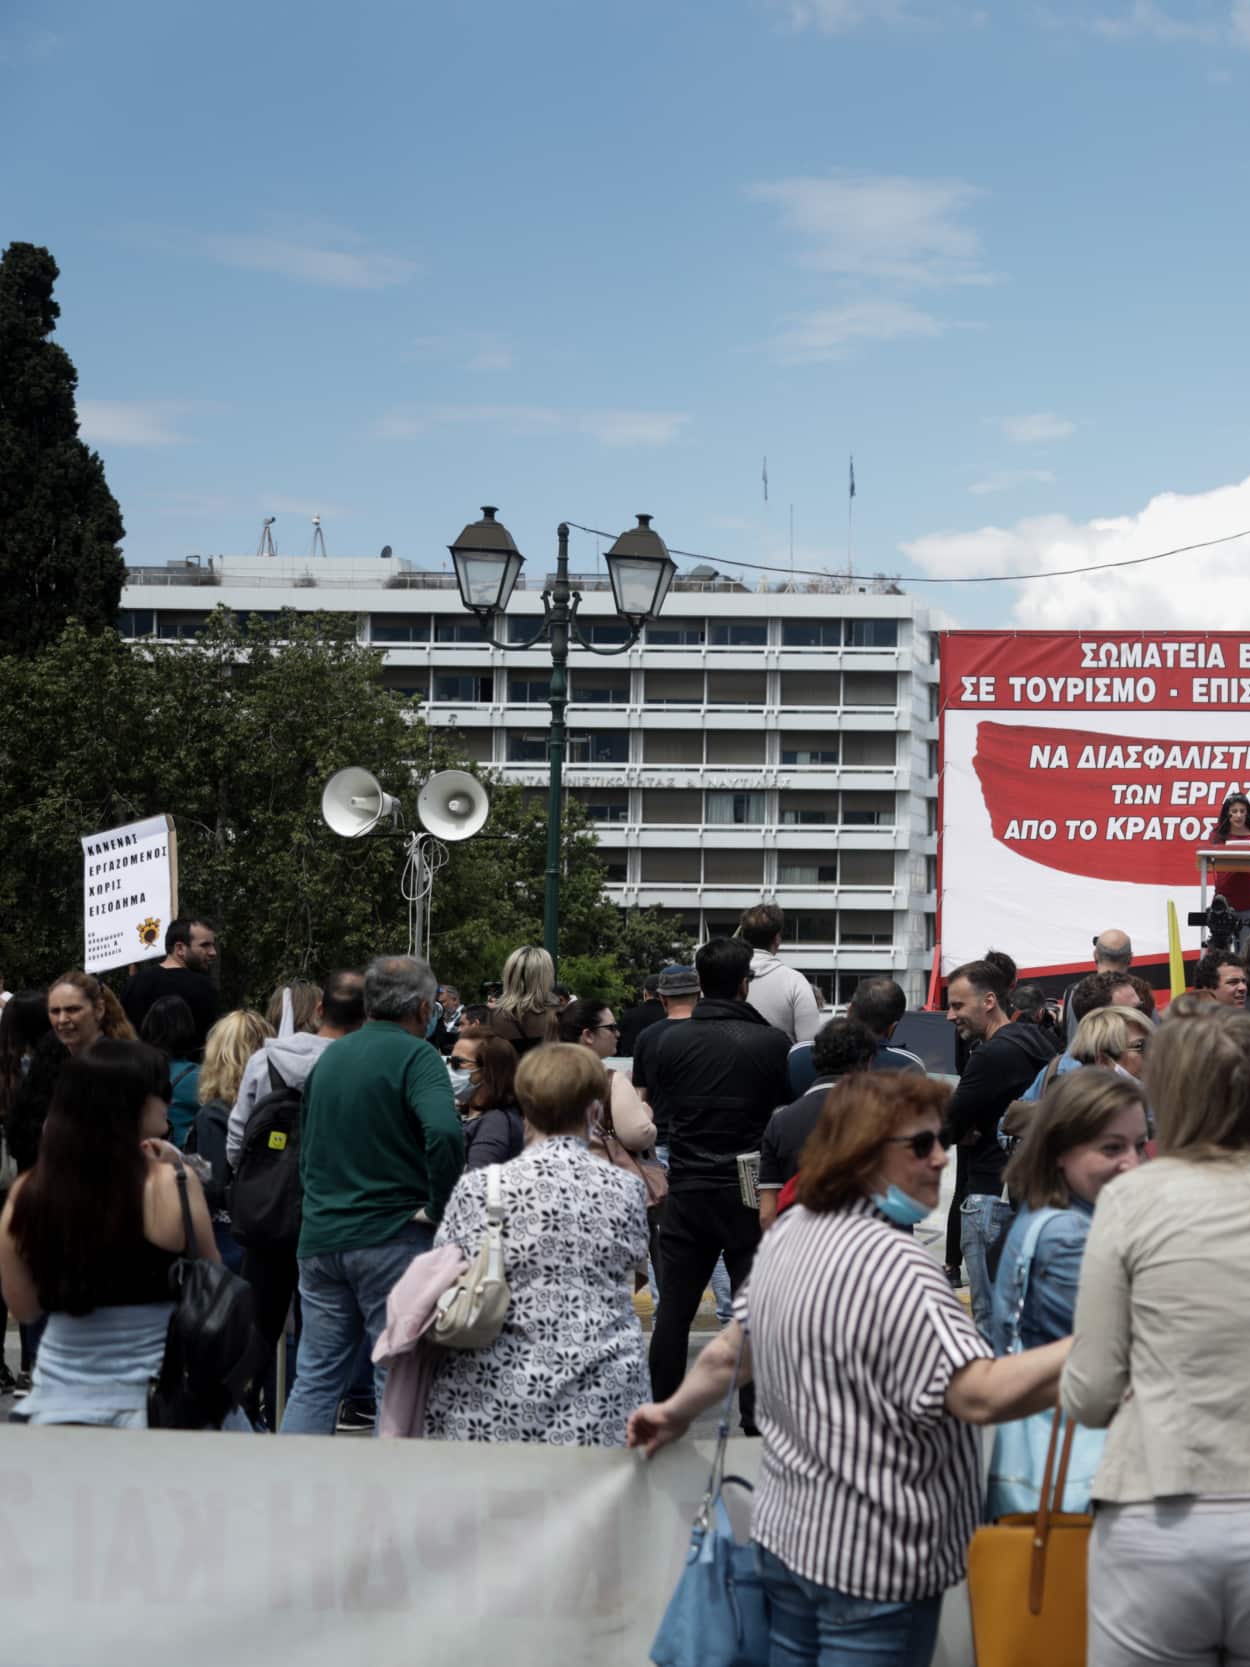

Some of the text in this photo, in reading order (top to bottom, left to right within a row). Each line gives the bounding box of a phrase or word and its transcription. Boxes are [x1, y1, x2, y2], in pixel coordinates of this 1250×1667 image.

[1080, 642, 1226, 669] ΣΩΜΑΤΕΙΑ
[960, 676, 996, 702] ΣΕ
[1008, 676, 1157, 703] ΤΟΥΡΙΣΜΟ
[1028, 744, 1069, 769] ΝΑ
[1111, 784, 1163, 805] ΤΩΝ
[1003, 819, 1057, 841] ΑΠΟ
[1065, 820, 1098, 841] ΤΟ
[1105, 816, 1219, 841] ΚΡΑΤΟΣ
[87, 833, 138, 857] ΚΑΝΕΝΑΣ
[88, 846, 168, 877] ΕΡΓΑΖΟΜΕΝΟΣ
[88, 878, 123, 897] ΧΩΡΙΣ
[88, 892, 147, 917] ΕΙΣΟΔΗΜΑ
